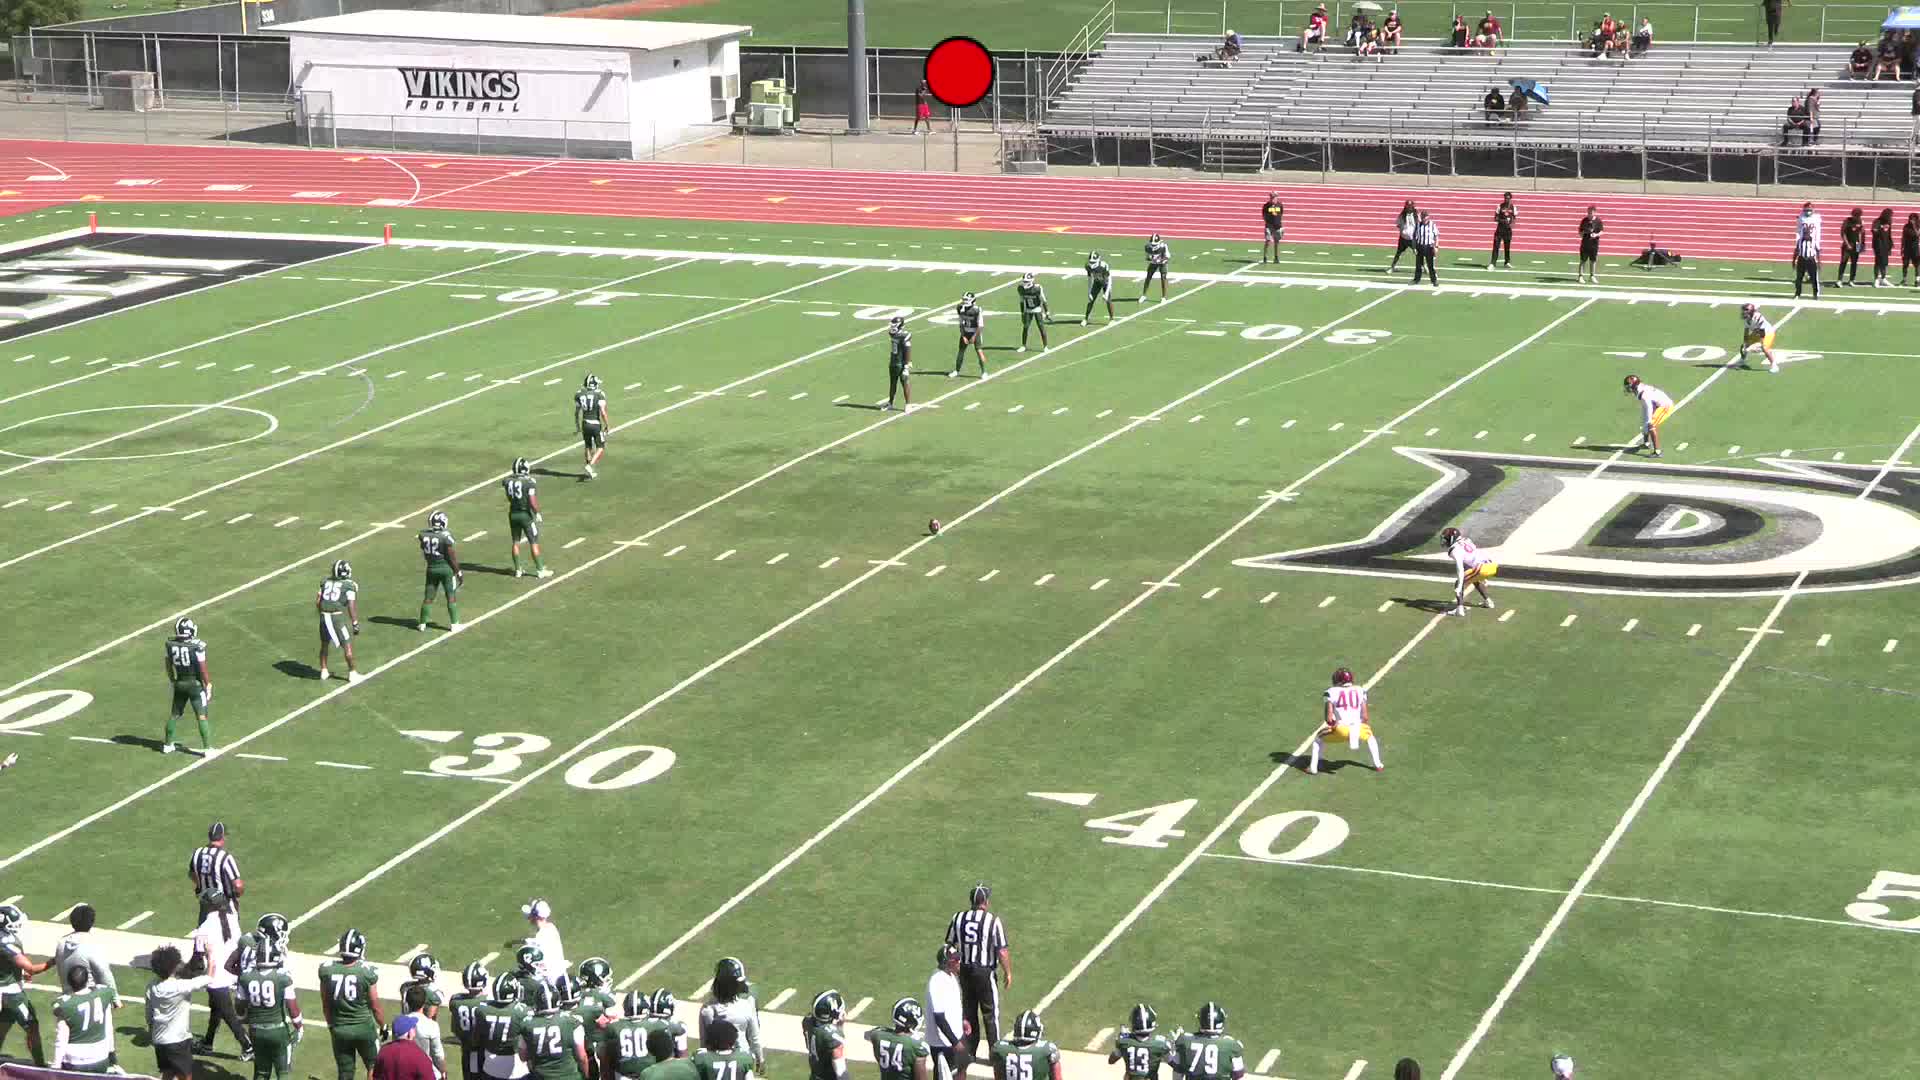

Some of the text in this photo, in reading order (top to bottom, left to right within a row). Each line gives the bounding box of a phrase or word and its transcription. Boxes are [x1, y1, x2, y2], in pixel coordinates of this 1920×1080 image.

[398, 68, 520, 101] VIKINGS
[405, 99, 519, 112] FOOTBALL
[508, 480, 522, 499] 43
[423, 537, 440, 556] 32
[323, 581, 343, 601] 25
[171, 646, 191, 667] 20
[1336, 690, 1359, 711] 40
[964, 922, 979, 944] S
[248, 980, 276, 1007] 89
[331, 974, 358, 1001] 76
[77, 997, 105, 1032] 74
[485, 1015, 512, 1042] 77
[533, 1025, 562, 1055] 72
[879, 1039, 904, 1071] 54
[1005, 1053, 1033, 1080] 65
[1127, 1046, 1149, 1073] 13
[1189, 1042, 1218, 1074] 79
[712, 1060, 737, 1080] 71
